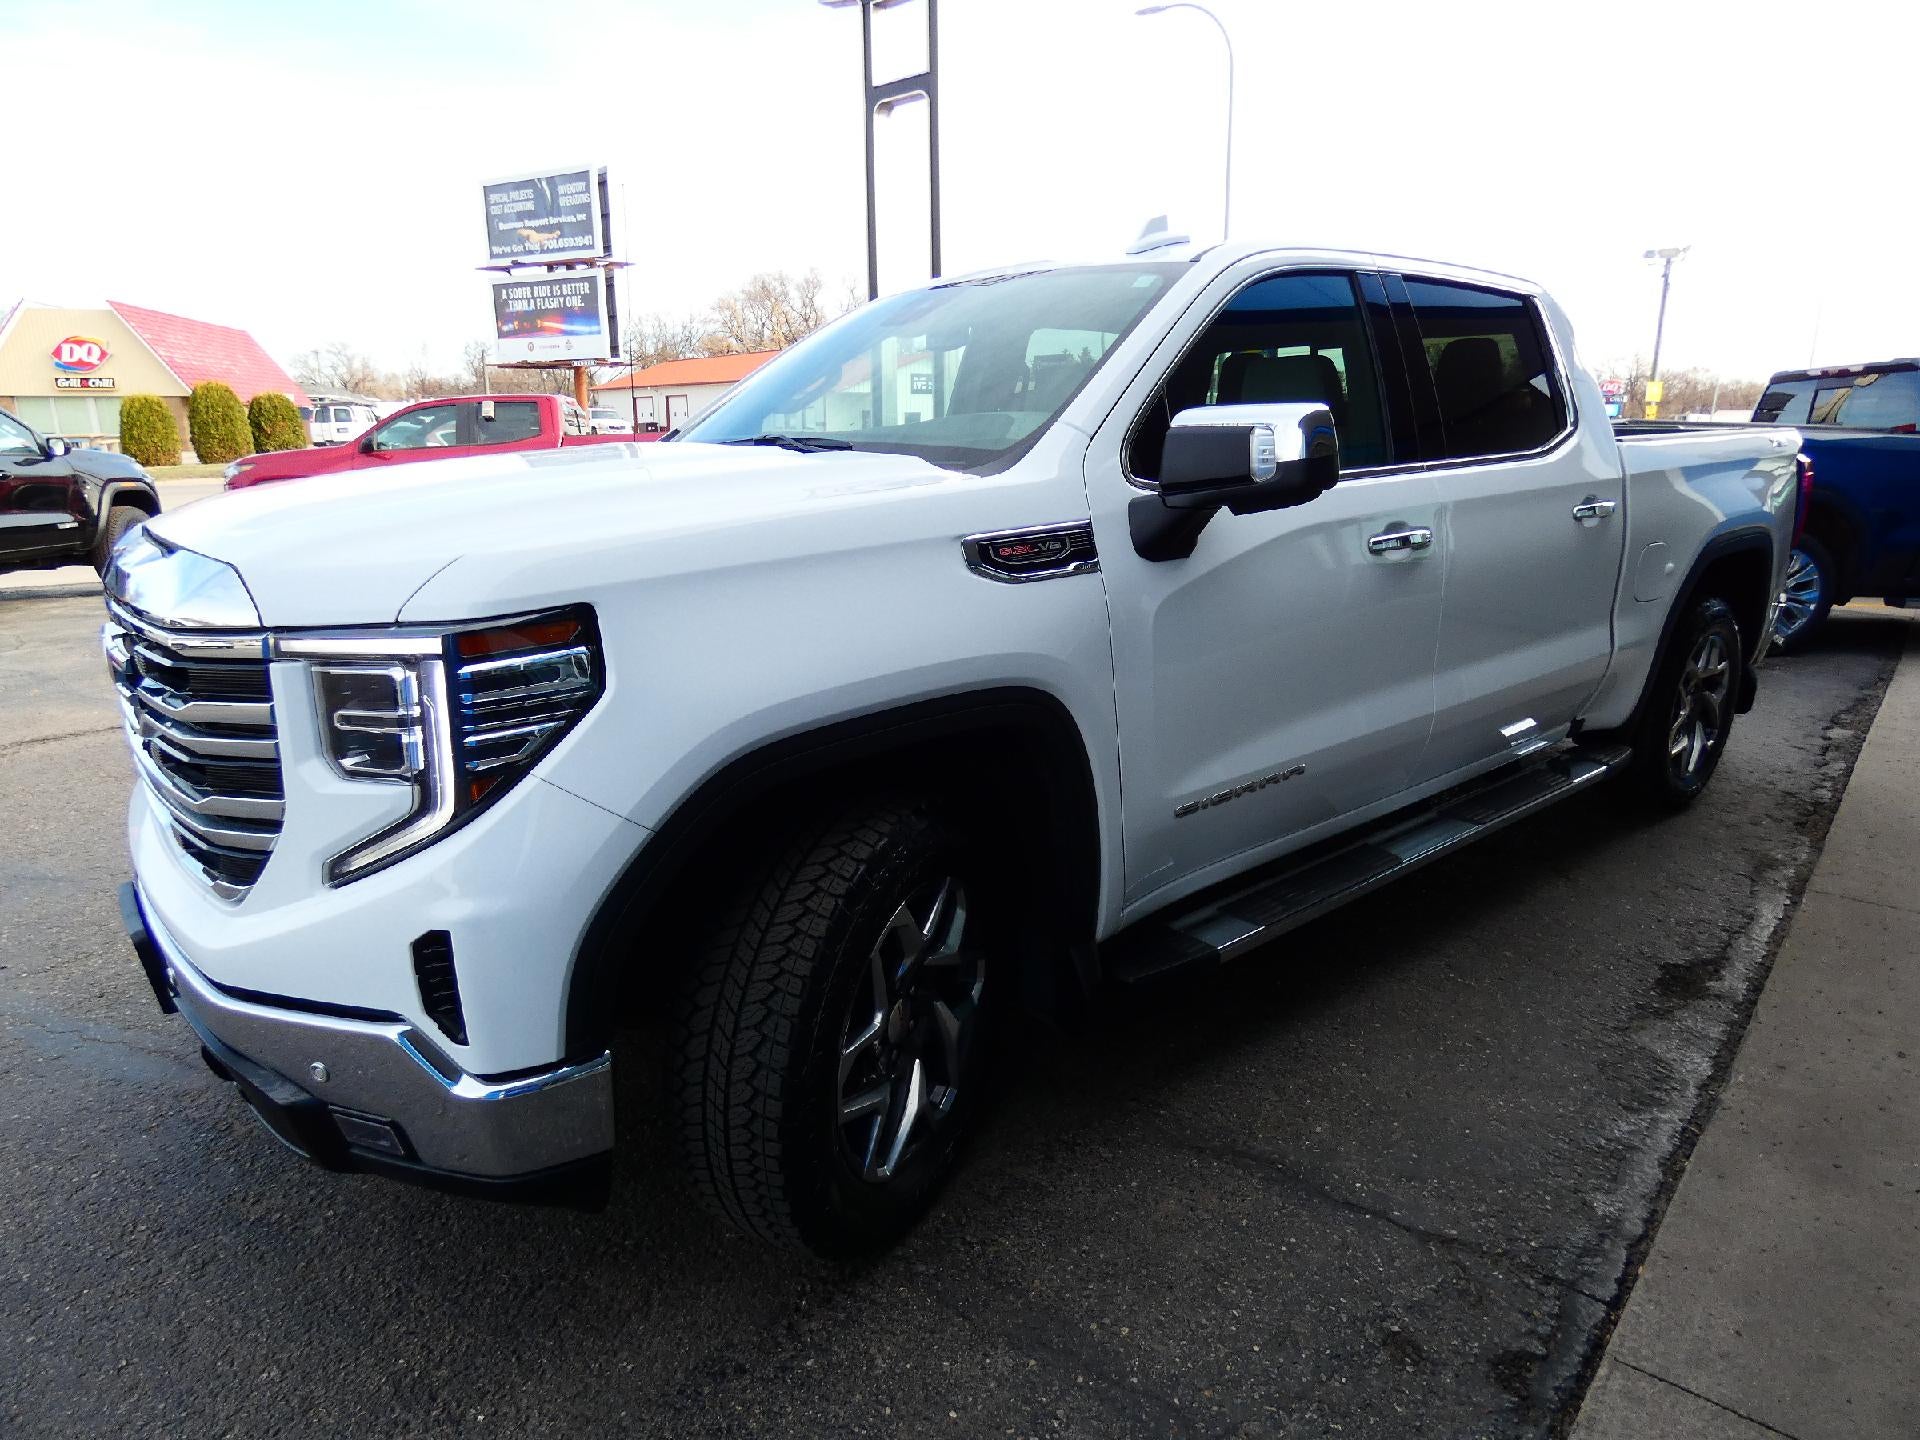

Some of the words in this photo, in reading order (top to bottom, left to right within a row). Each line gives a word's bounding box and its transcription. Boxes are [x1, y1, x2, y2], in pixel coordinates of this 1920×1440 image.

[502, 288, 507, 300] A
[509, 286, 532, 299] SOBER
[533, 285, 551, 297] RIDE
[553, 284, 561, 296] IS
[562, 282, 590, 295] BETTER
[508, 299, 530, 310] THAN
[529, 299, 535, 310] A
[537, 297, 564, 309] FLASHY
[566, 295, 585, 307] ONE.
[60, 343, 102, 364] DQ
